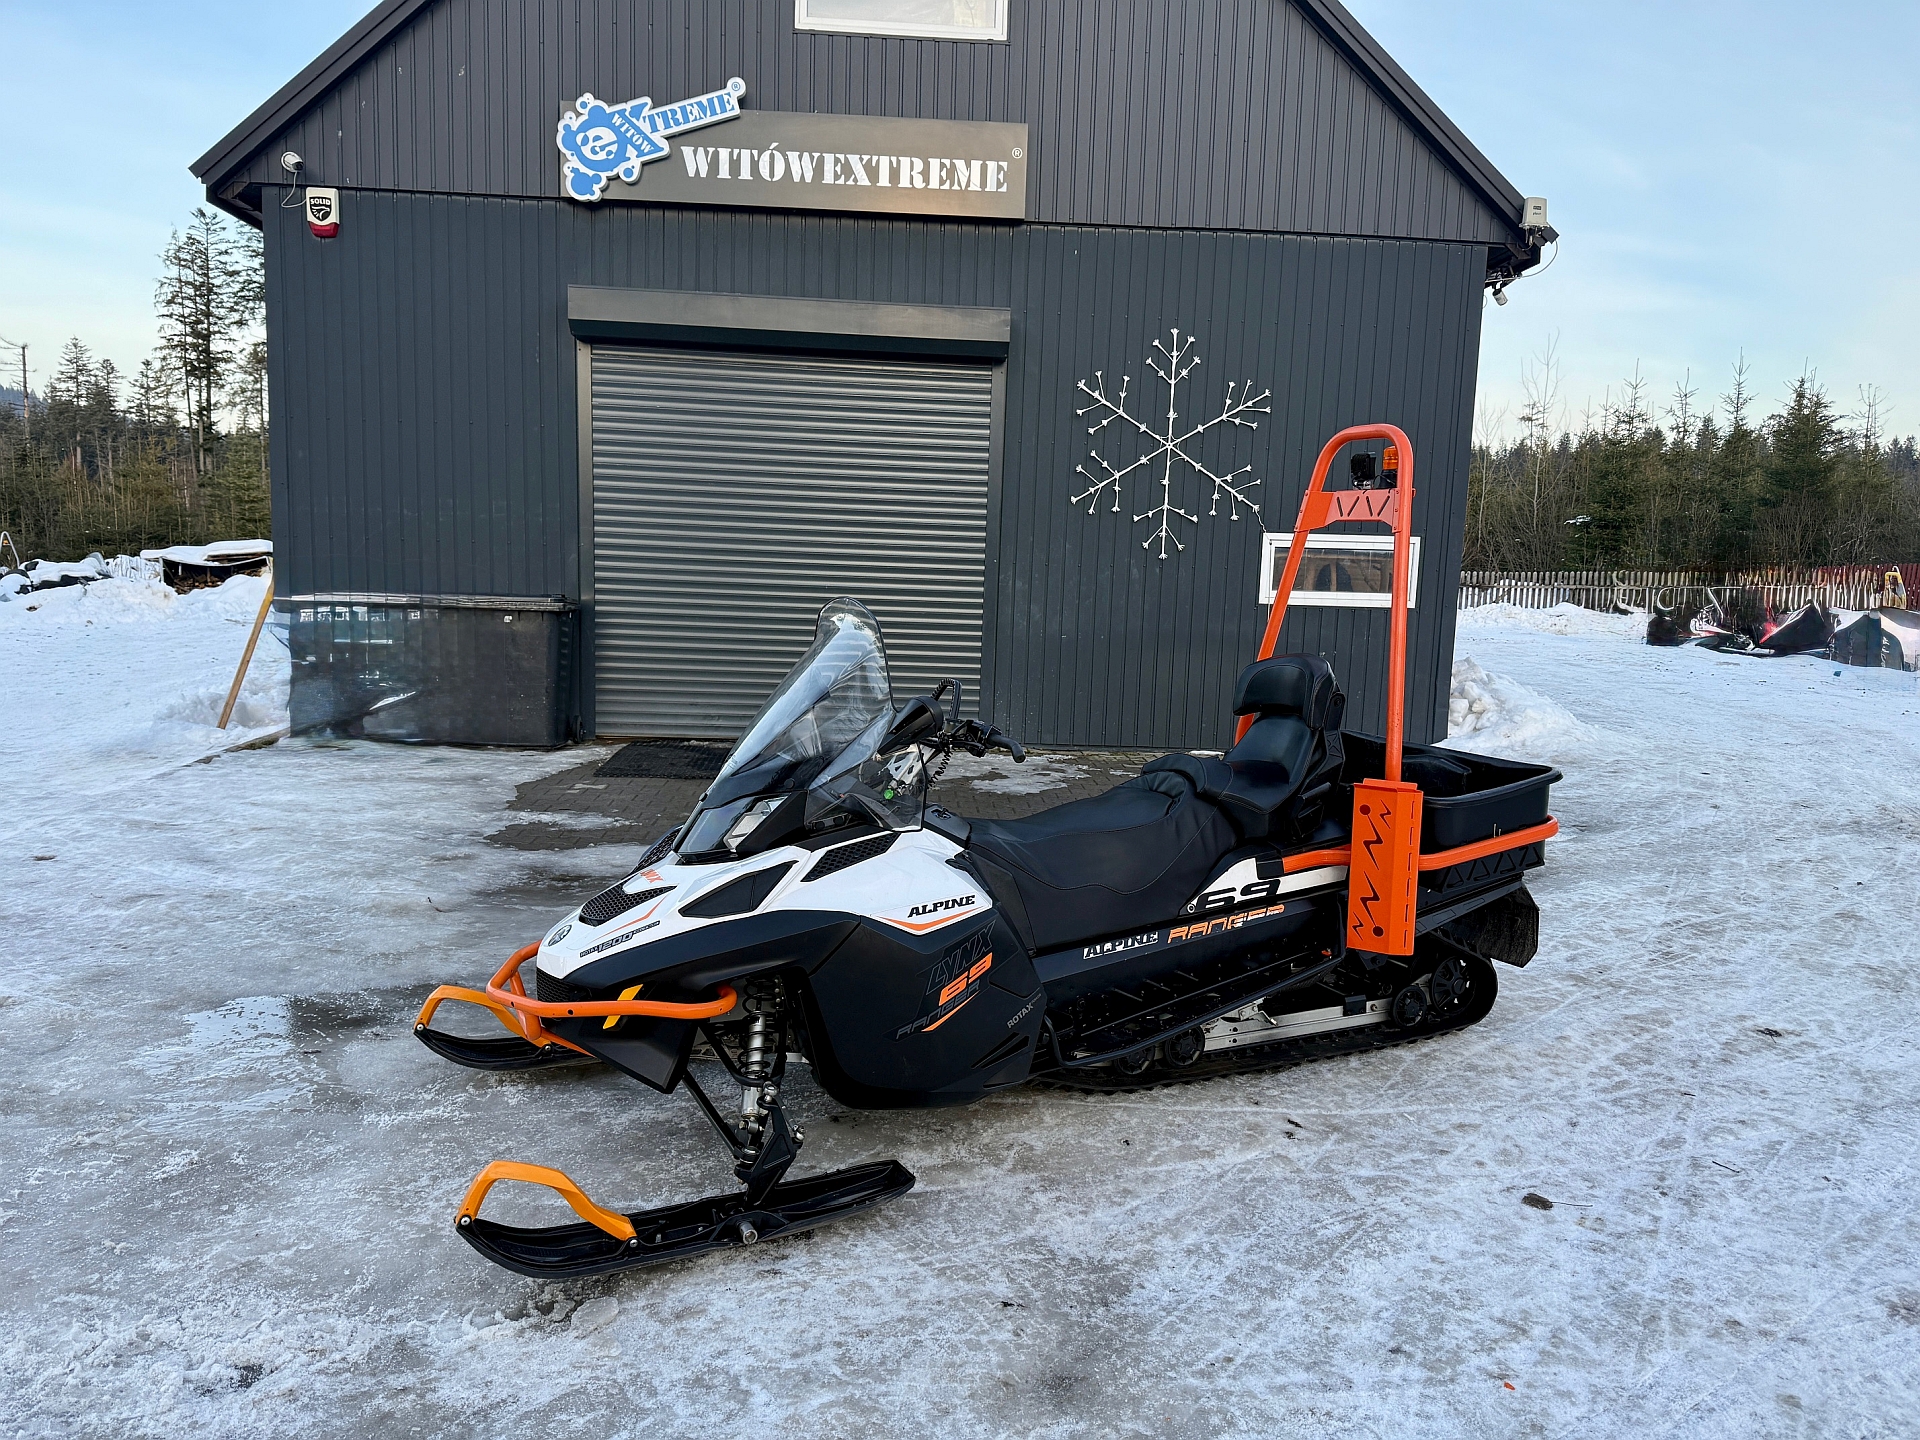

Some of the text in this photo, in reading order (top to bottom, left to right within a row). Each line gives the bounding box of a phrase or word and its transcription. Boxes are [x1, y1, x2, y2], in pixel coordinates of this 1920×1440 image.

[611, 113, 655, 155] WITÓW
[680, 142, 1009, 193] WITÓWEXTREME
[907, 894, 976, 918] ALPINE
[1195, 879, 1281, 909] 69
[926, 920, 997, 996] LYNX
[1083, 931, 1159, 959] ALPINE
[939, 952, 993, 1007] 69
[896, 979, 981, 1040] RANGER
[1006, 1002, 1034, 1029] ROTAX
